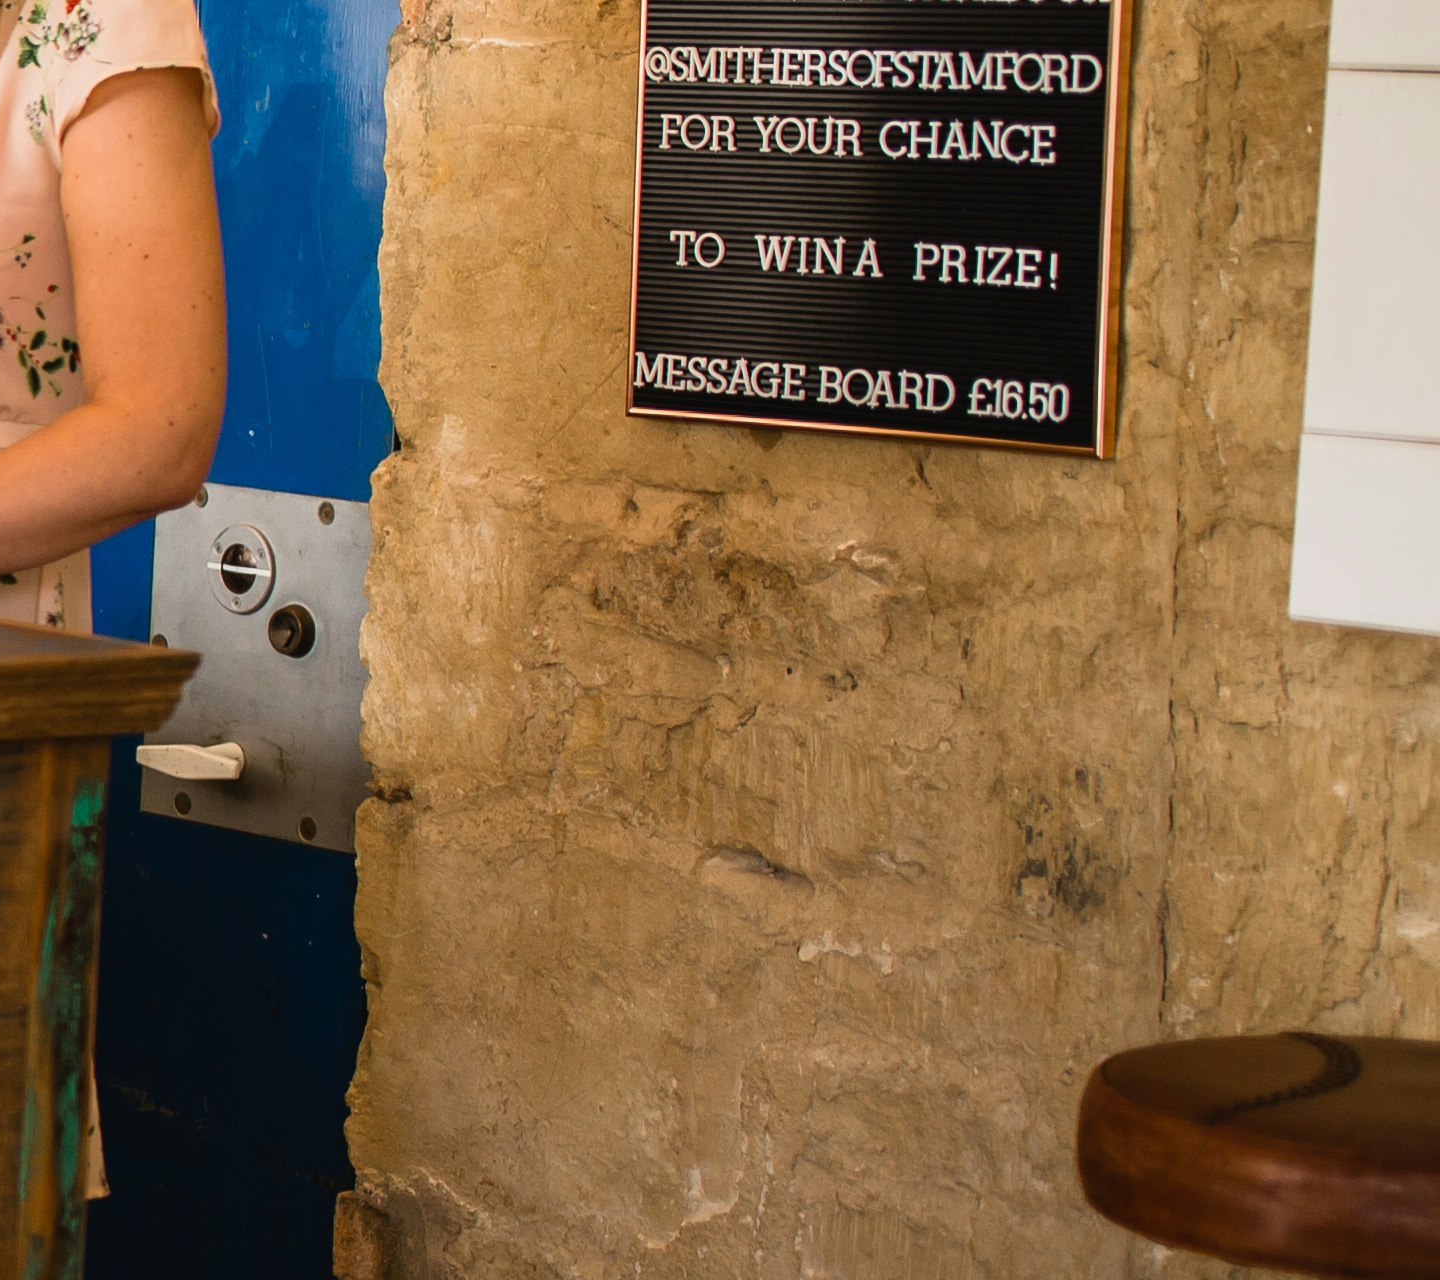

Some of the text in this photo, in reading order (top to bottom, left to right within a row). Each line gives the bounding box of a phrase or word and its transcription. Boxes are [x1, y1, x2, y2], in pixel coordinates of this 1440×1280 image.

[644, 45, 1104, 95] @SMITHERSOFSTAMFORD
[659, 113, 1058, 166] FOR YOUR CHANCE
[670, 230, 1060, 291] TO WIN A PRIZE!
[632, 351, 1071, 424] MESSAGE BOARD £16.50
